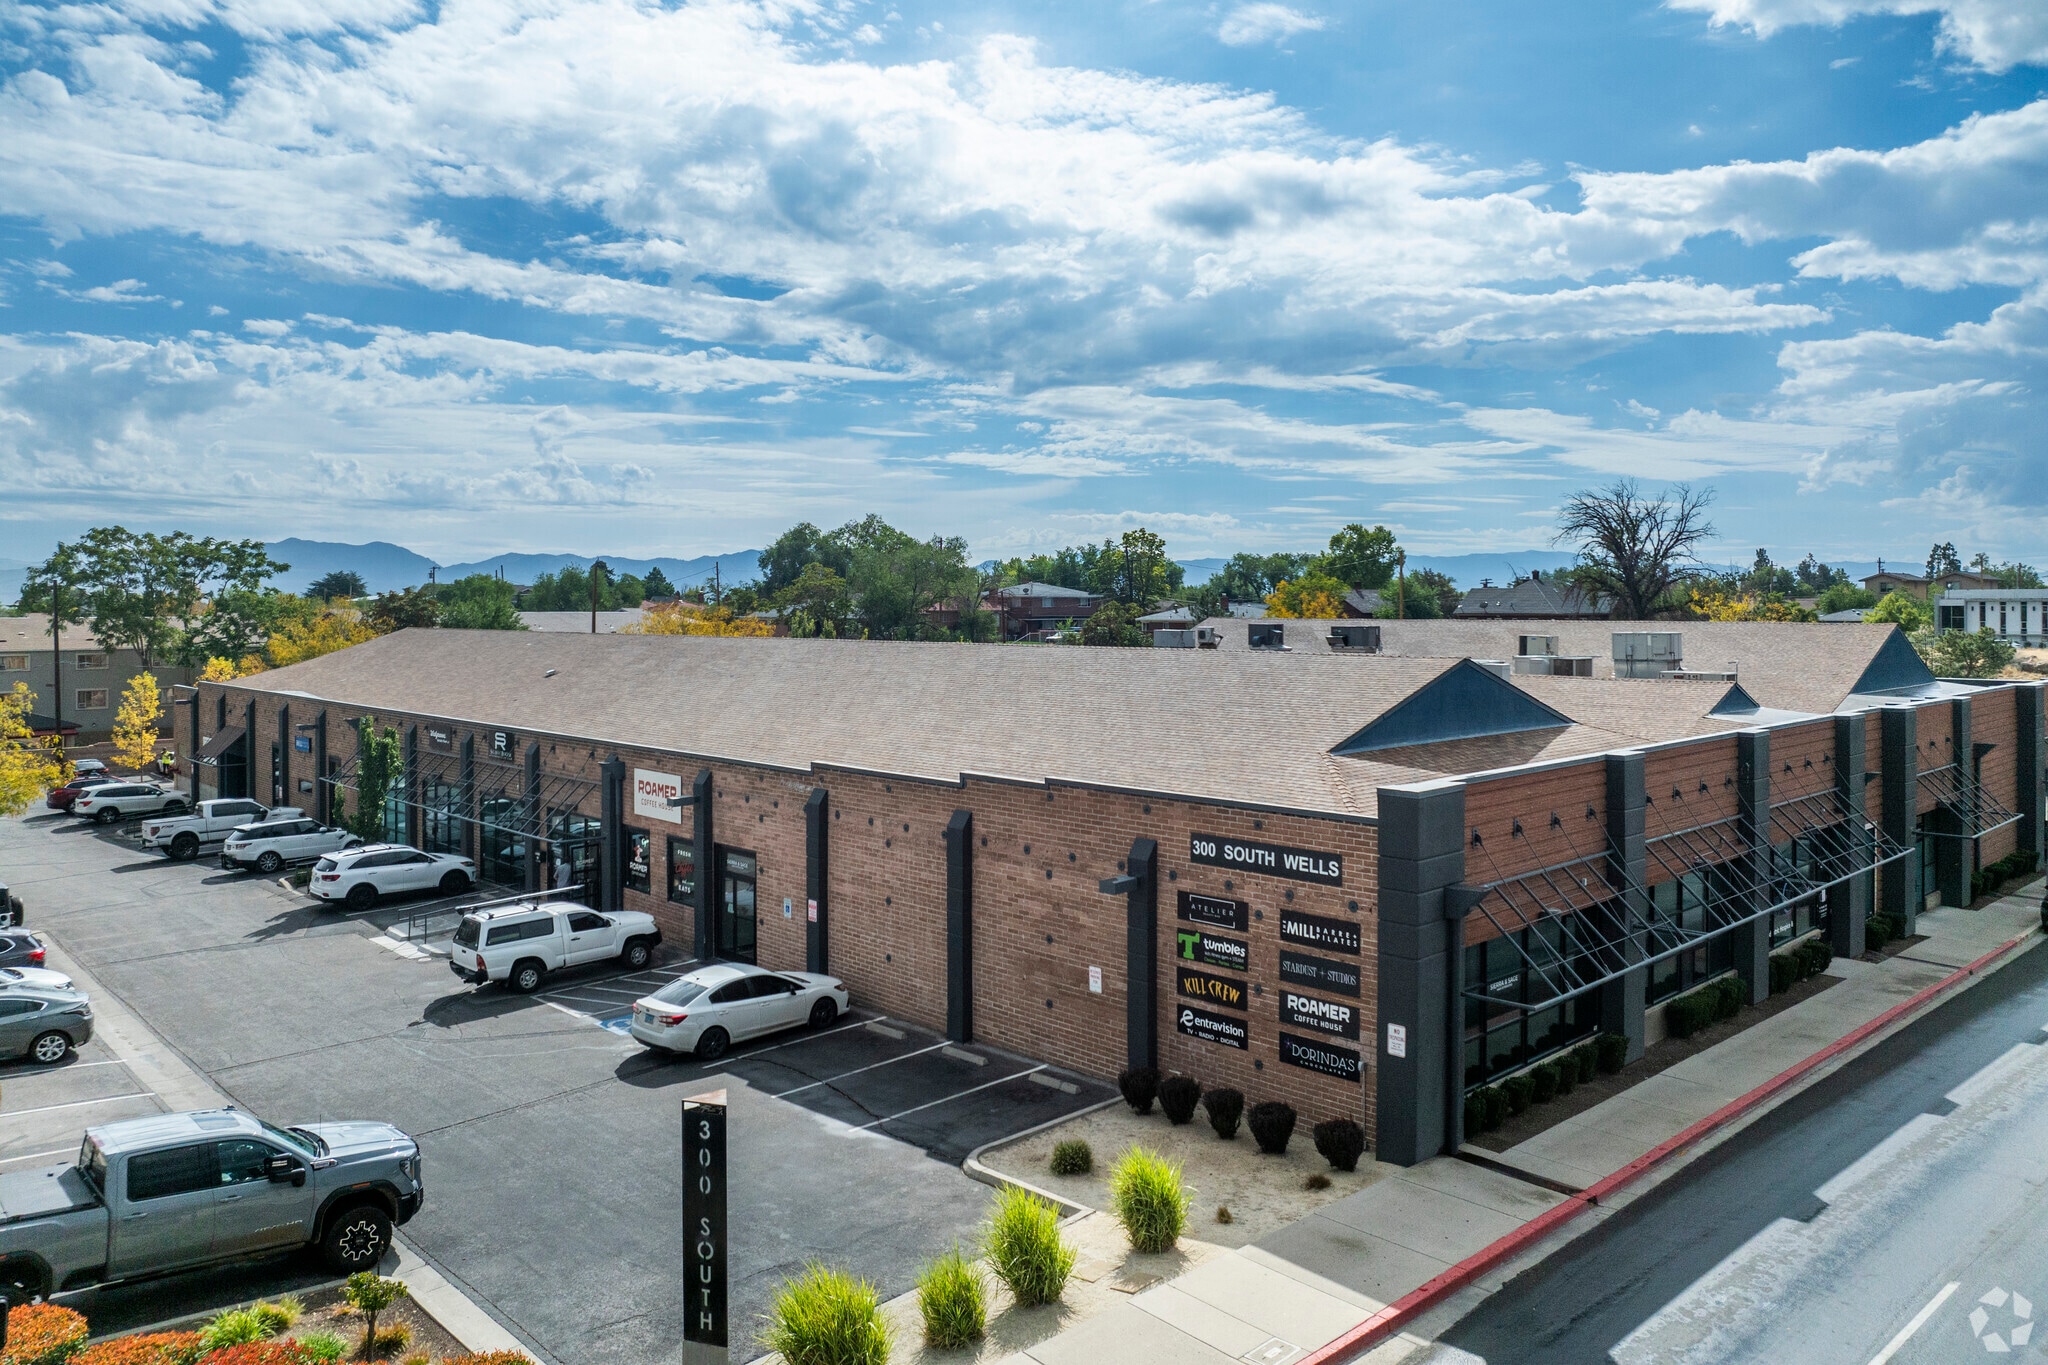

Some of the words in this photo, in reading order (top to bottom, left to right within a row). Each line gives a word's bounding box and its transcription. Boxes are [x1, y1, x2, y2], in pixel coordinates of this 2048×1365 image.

[638, 780, 677, 798] ROAMER
[641, 798, 657, 808] COFFEE
[1192, 840, 1216, 857] 300
[1224, 845, 1275, 867] SOUTH
[1284, 854, 1340, 877] WELLS
[678, 884, 691, 894] EATS
[1191, 903, 1234, 917] ATELIER
[1287, 920, 1316, 940] MILL
[1316, 926, 1350, 939] BARRE
[1203, 938, 1246, 957] tumbles
[1316, 933, 1358, 948] PILATES
[1282, 960, 1317, 978] STARDUST
[1327, 970, 1357, 986] STUDIOS
[1184, 977, 1207, 996] KILL
[1208, 979, 1241, 1004] CREW
[1287, 994, 1350, 1023] ROAMER
[1194, 1017, 1244, 1038] entravision
[1294, 1013, 1318, 1027] COFFEE
[1320, 1020, 1343, 1033] HOUSE
[1199, 1031, 1215, 1041] RADIO
[1220, 1036, 1240, 1048] DIGITAL
[1292, 1044, 1355, 1072] DORINDA'S
[699, 1120, 711, 1195] 300
[697, 1217, 714, 1331] SOUTH
